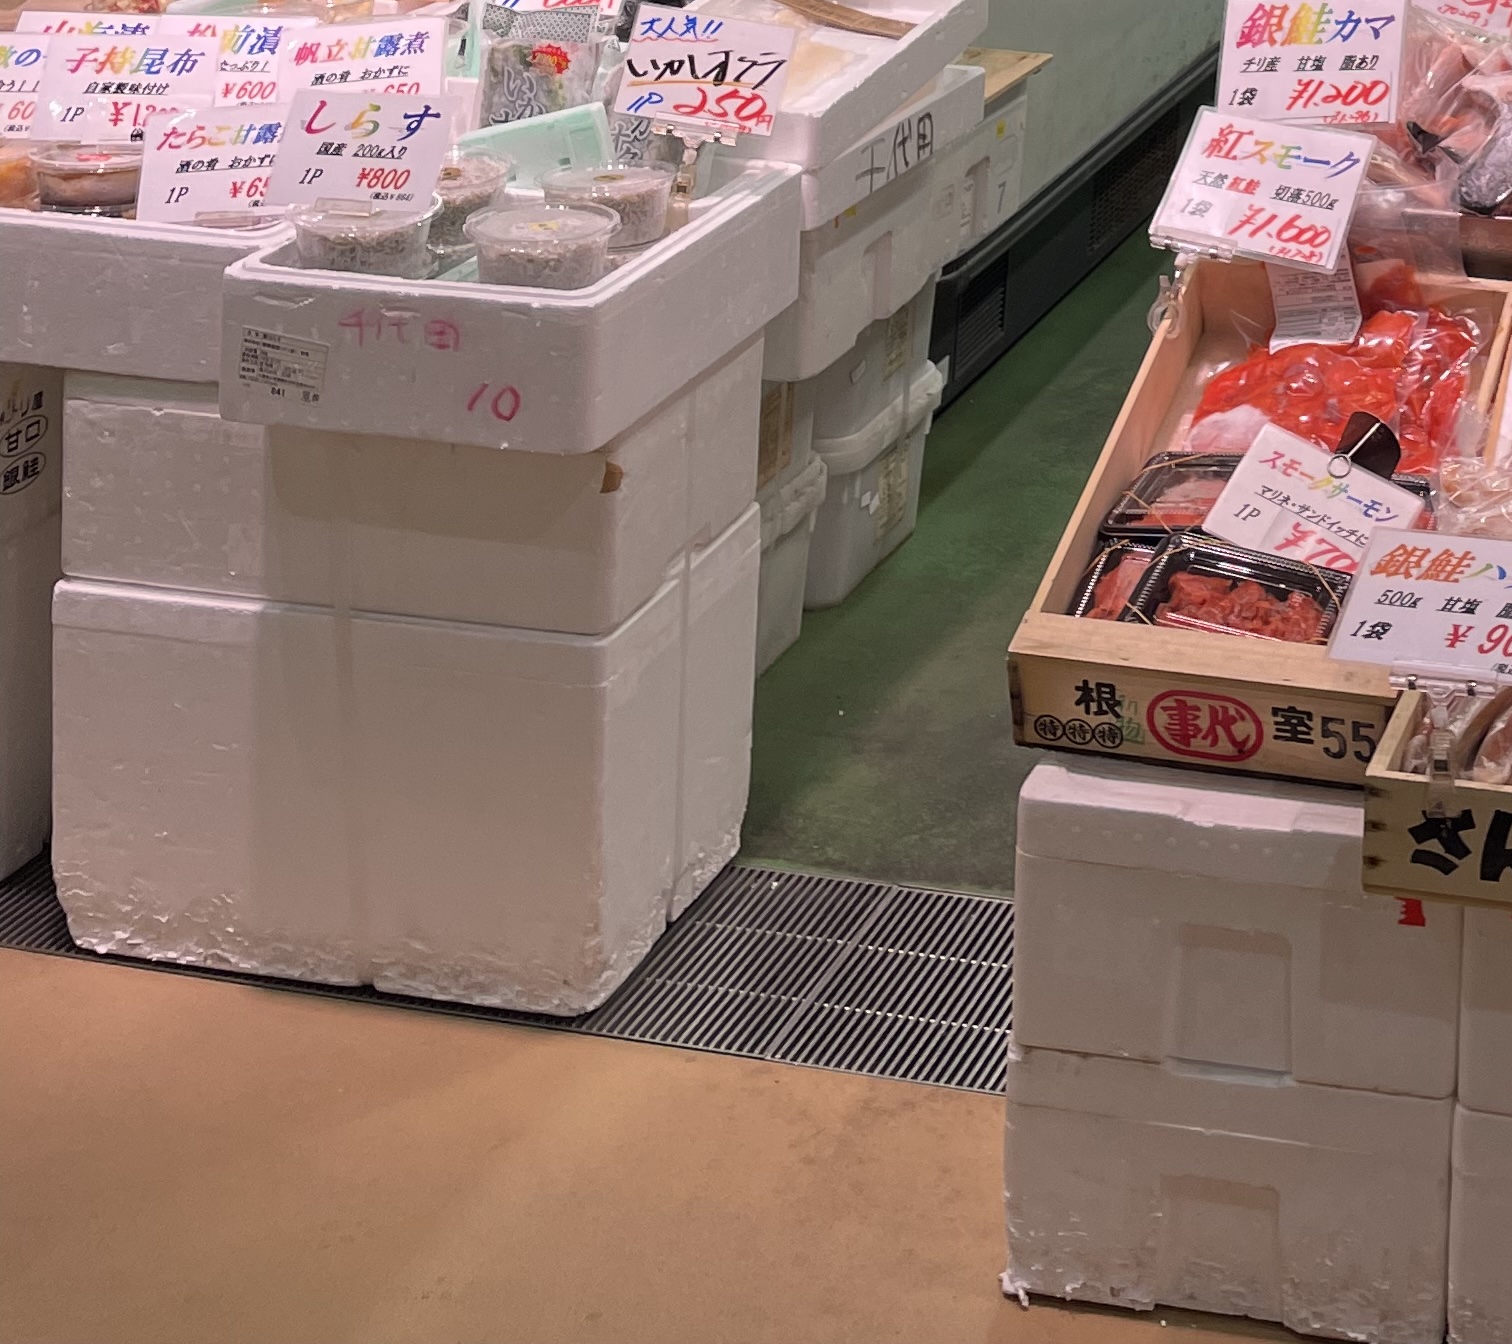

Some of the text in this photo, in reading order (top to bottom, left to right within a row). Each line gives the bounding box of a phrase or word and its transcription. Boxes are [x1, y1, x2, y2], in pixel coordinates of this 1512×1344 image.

[1236, 3, 1396, 49] 銀鮭カマ
[294, 31, 430, 66] 帆立甘露煮
[66, 47, 206, 76] 子持昆布
[362, 66, 410, 81] おかずに
[1240, 55, 1379, 72] チリ産 甘塩 脂あり
[1228, 88, 1259, 106] 1袋
[61, 107, 84, 122] 1P
[304, 100, 441, 141] しらす
[316, 142, 407, 159] 国産 200g入り
[1202, 123, 1361, 179] 紅スモーク
[299, 168, 323, 185] 1P
[1193, 170, 1260, 195] 天然紅鮭
[165, 187, 189, 204] 1P
[1179, 198, 1213, 217] 1袋
[467, 383, 521, 421] 10
[1258, 450, 1400, 523] スモークサーモン
[1232, 503, 1261, 523] 1P
[1254, 483, 1368, 548] マリネ・サンドイッチに
[1375, 588, 1424, 607] 500g
[1436, 595, 1482, 614] 甘塩
[1350, 620, 1393, 641] 1袋
[1074, 680, 1377, 762] 根 室 55
